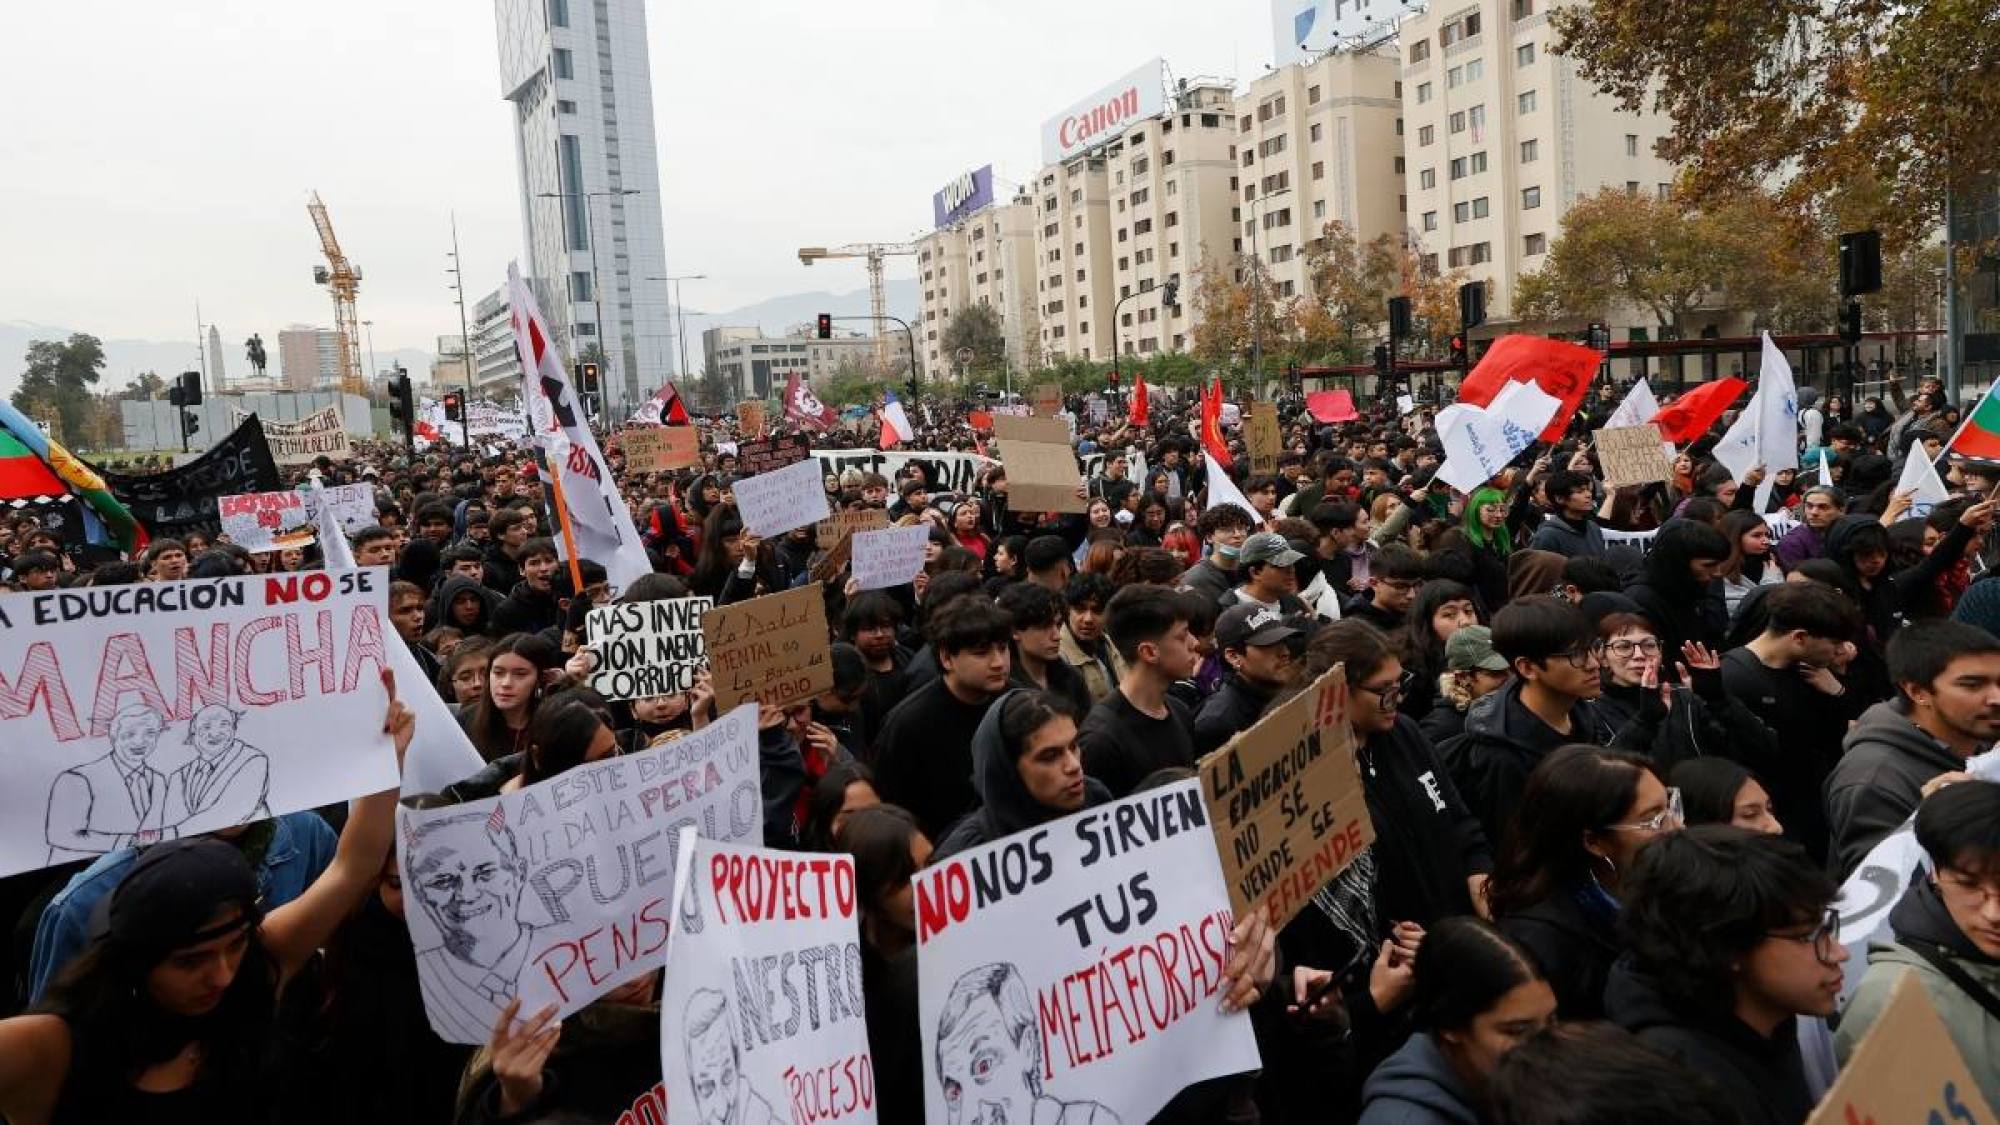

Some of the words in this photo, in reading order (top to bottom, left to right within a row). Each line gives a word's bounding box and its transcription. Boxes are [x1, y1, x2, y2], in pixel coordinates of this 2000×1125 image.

[1059, 86, 1137, 149] Canon
[265, 572, 331, 605] NO
[340, 571, 374, 594] SE
[589, 599, 644, 641] MÁS
[0, 604, 385, 741] MANCHA
[714, 641, 776, 671] MENTAL
[519, 792, 544, 826] A
[551, 763, 628, 811] ESTE
[637, 718, 739, 781] DEMONIO
[528, 830, 553, 866] LE
[563, 812, 597, 850] DA
[603, 799, 636, 832] LA
[638, 761, 722, 819] PERA
[726, 742, 750, 774] UN
[1211, 750, 1244, 801] LA
[1229, 723, 1322, 829] EDUCACIÓN
[1233, 822, 1259, 870] NO
[1281, 780, 1310, 829] SE
[1240, 838, 1294, 903] VENDE
[1310, 802, 1335, 839] SE
[711, 853, 855, 924] PROYECTO
[917, 862, 970, 945] NO
[971, 829, 1053, 909] NOS
[1057, 871, 1158, 948] TUS
[1255, 819, 1363, 928] EFIENDE
